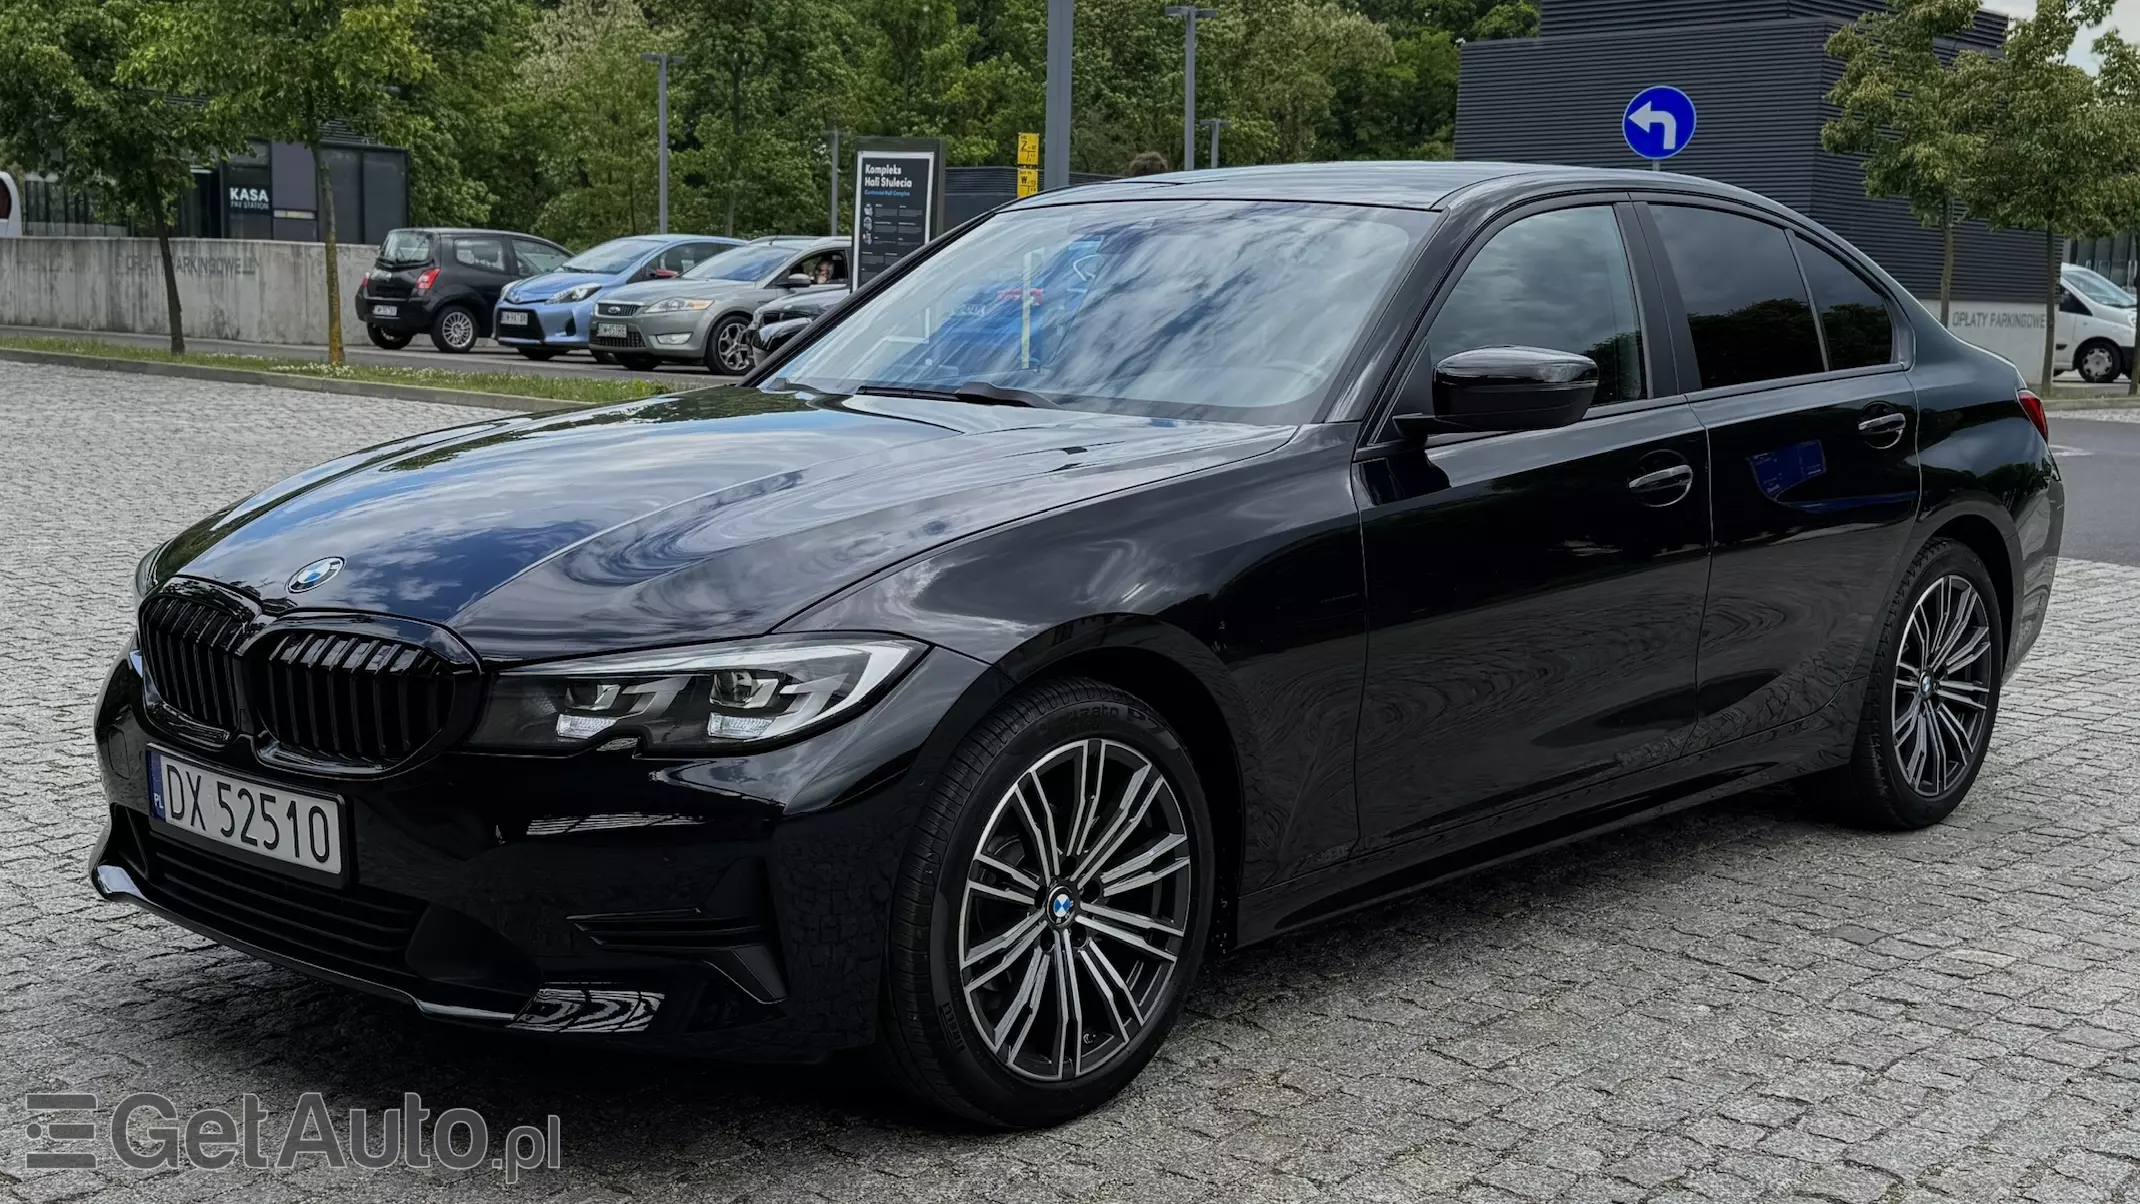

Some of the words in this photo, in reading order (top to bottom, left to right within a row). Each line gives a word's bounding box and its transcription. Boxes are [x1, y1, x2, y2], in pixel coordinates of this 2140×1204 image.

[865, 164, 902, 176] Kompleks
[864, 176, 880, 187] Hali
[880, 176, 913, 188] Stulecia
[229, 187, 269, 202] KASA
[243, 201, 269, 210] STATION
[172, 256, 241, 277] ARKINGOWE
[1989, 312, 2046, 329] PARKINGOWE
[153, 792, 164, 809] PL
[166, 764, 207, 831] DX
[216, 781, 330, 863] 52510
